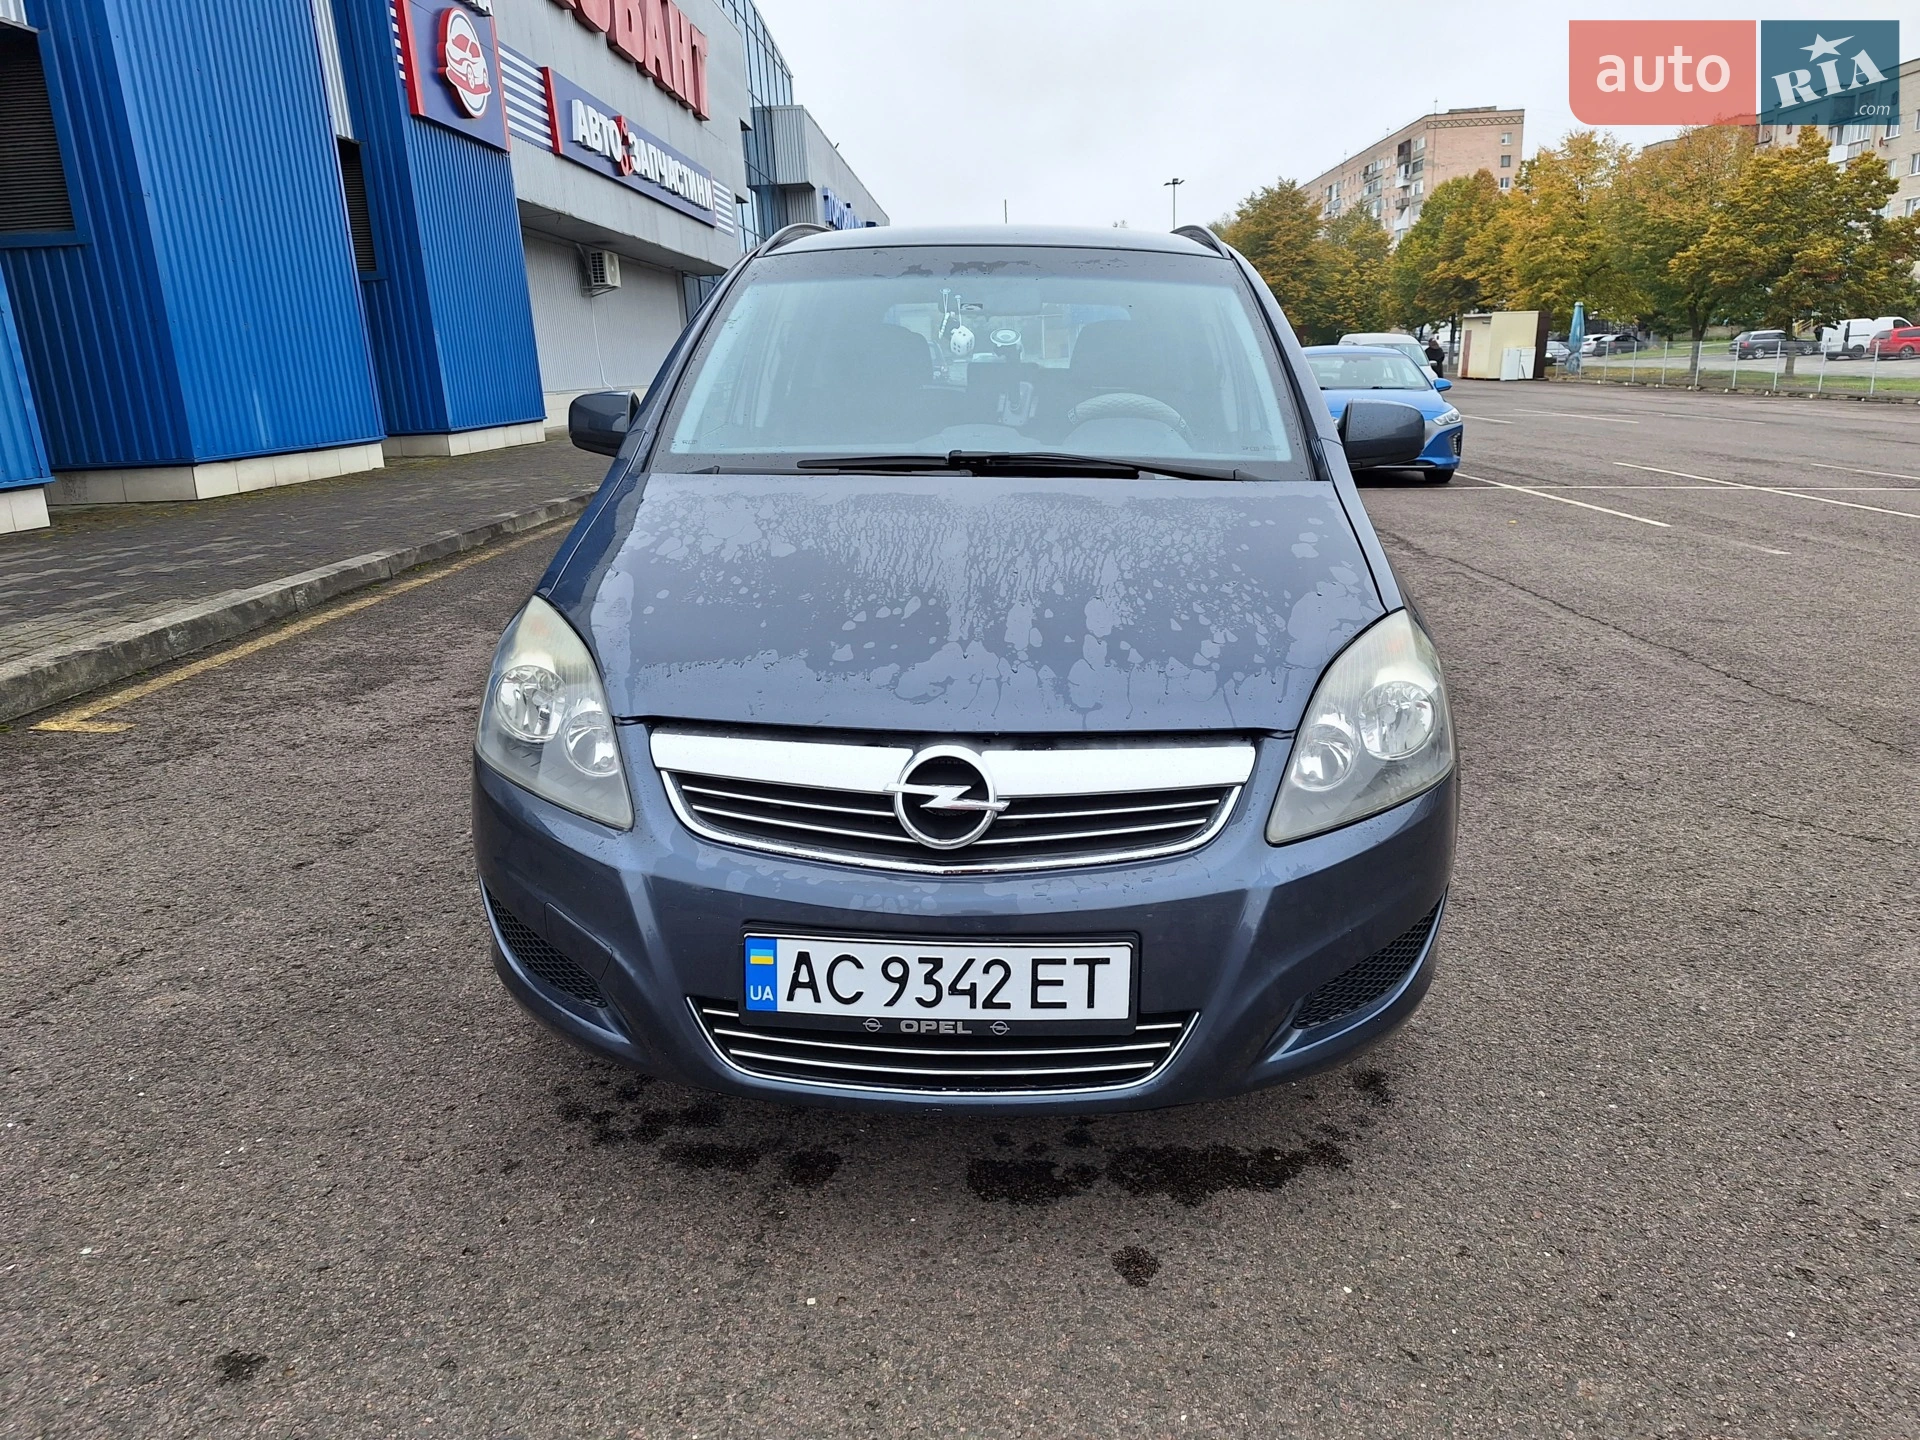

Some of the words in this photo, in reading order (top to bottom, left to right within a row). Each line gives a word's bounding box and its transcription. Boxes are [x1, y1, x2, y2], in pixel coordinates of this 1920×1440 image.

[786, 950, 864, 1005] AC
[881, 956, 1012, 1010] 9342
[1030, 957, 1110, 1009] ET
[750, 985, 774, 1001] UA
[900, 1020, 973, 1035] OPEL
